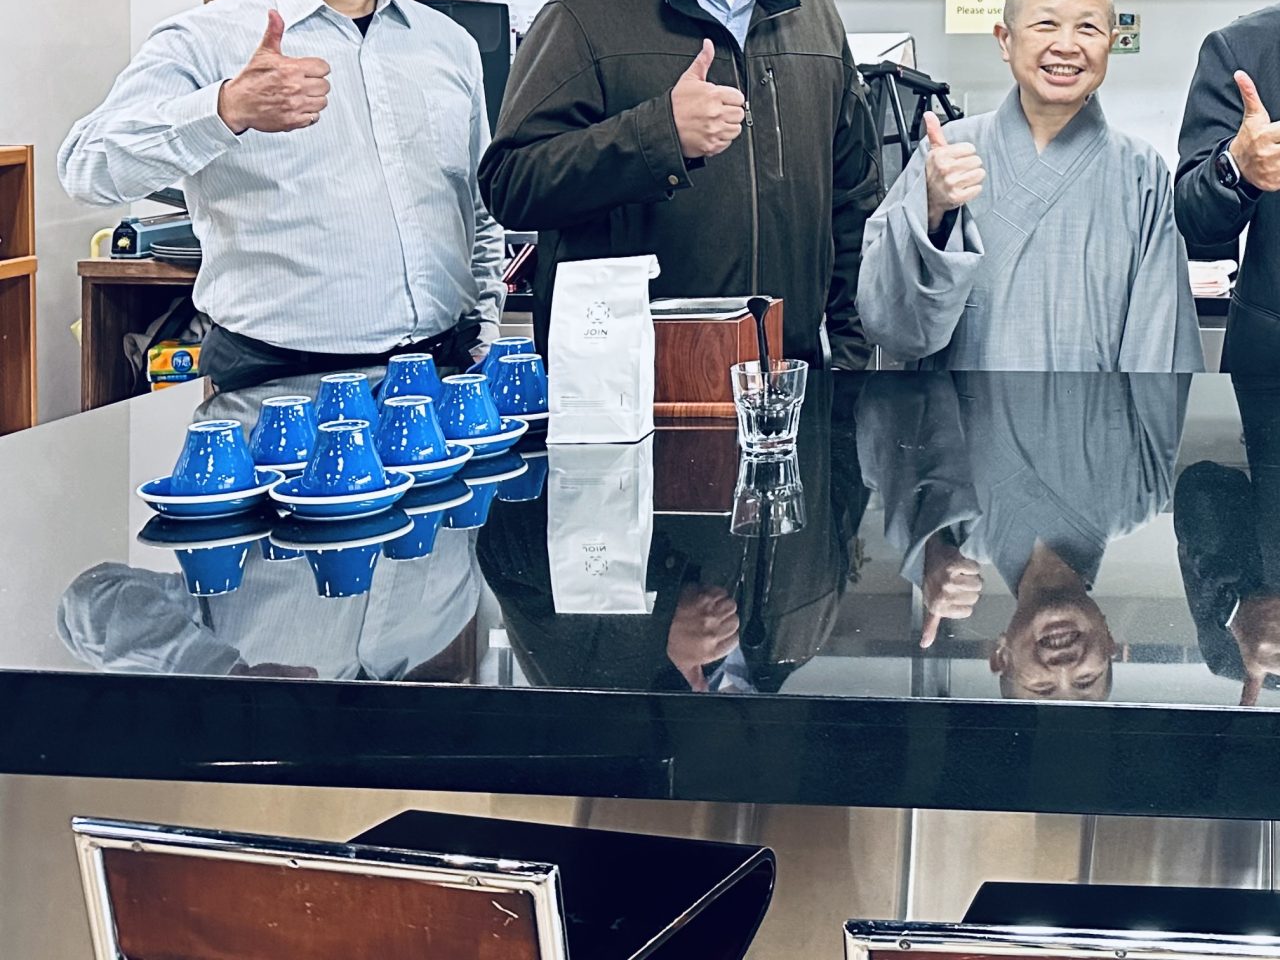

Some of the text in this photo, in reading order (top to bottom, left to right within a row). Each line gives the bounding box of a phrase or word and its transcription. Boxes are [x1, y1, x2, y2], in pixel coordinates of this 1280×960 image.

[956, 6, 1003, 15] Please use
[583, 328, 608, 336] JOIN
